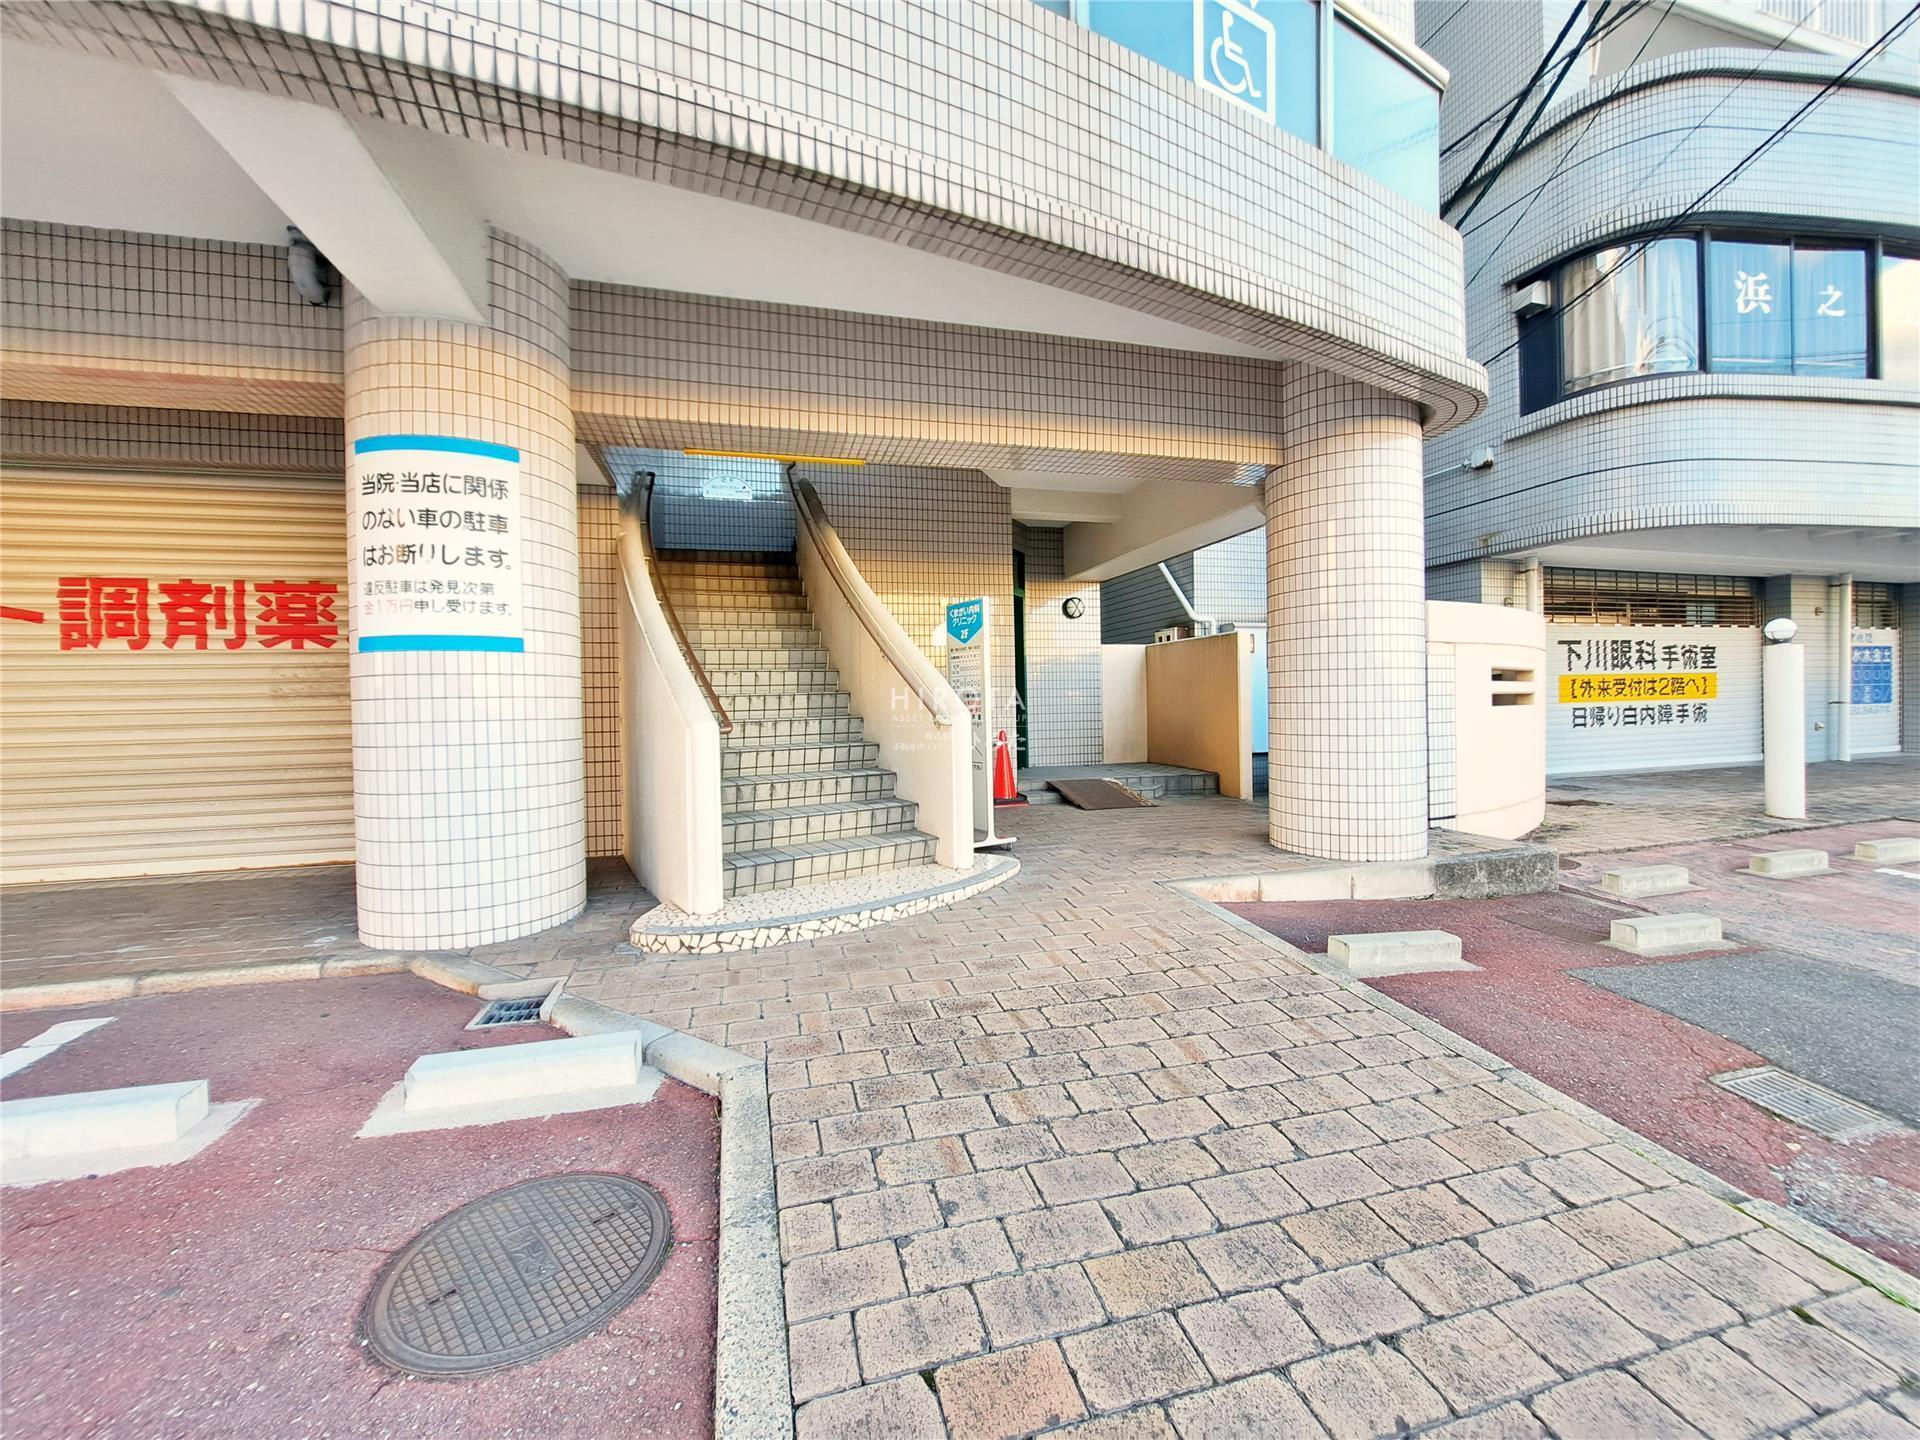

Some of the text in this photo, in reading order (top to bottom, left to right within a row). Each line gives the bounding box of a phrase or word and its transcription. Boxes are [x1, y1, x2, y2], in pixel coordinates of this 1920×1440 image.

[1734, 270, 1846, 317] 浜 之
[362, 508, 509, 534] のない車の駐車
[363, 544, 511, 571] はお断りします。
[364, 579, 495, 596] 違反駐車は発見次第
[952, 614, 977, 627] クリニック
[960, 628, 969, 640] 2F
[1557, 639, 1718, 671] 下川眼科 手術室
[1571, 702, 1709, 729] 日帰り白内障手術
